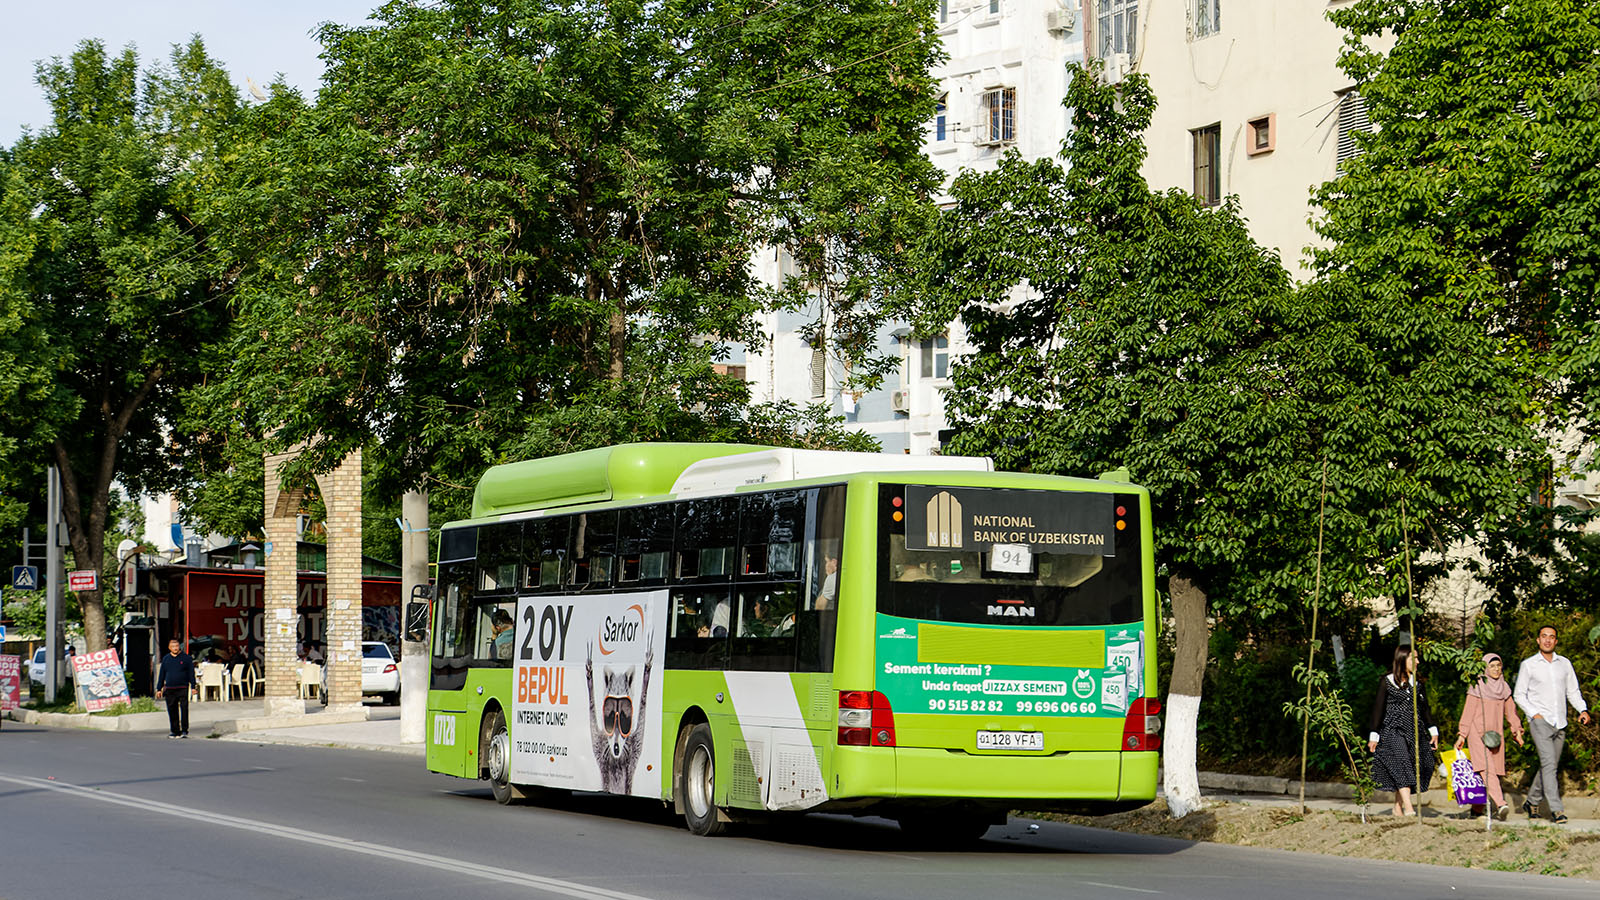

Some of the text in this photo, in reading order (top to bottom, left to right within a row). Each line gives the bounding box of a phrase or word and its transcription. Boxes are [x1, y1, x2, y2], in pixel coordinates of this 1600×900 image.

[973, 514, 1036, 528] NATIONAL
[928, 531, 963, 546] NBU
[973, 530, 1105, 546] BANK OF UZBEKISTAN
[1001, 550, 1022, 566] 94
[986, 605, 1036, 617] MAN
[519, 604, 574, 662] 2 OY
[603, 615, 640, 643] Sarkor
[75, 649, 114, 665] OLOT
[1112, 655, 1132, 669] 450
[76, 659, 116, 671] SOMSA
[884, 661, 992, 676] Sement kerakmi ?
[517, 666, 569, 705] BEPUL
[921, 679, 1064, 694] Unda faqat JIZZAX SEMENT
[1105, 684, 1120, 695] 450
[928, 698, 1003, 712] 90 515 82 82
[1016, 701, 1097, 714] 99 696 06 60
[517, 710, 545, 726] INTERNET
[433, 714, 456, 746] 07128
[992, 733, 1012, 745] 128
[1014, 734, 1036, 746] YFA
[523, 741, 531, 753] 122
[531, 742, 538, 754] 00
[539, 742, 546, 754] 00
[546, 744, 568, 756] sarkor.uz
